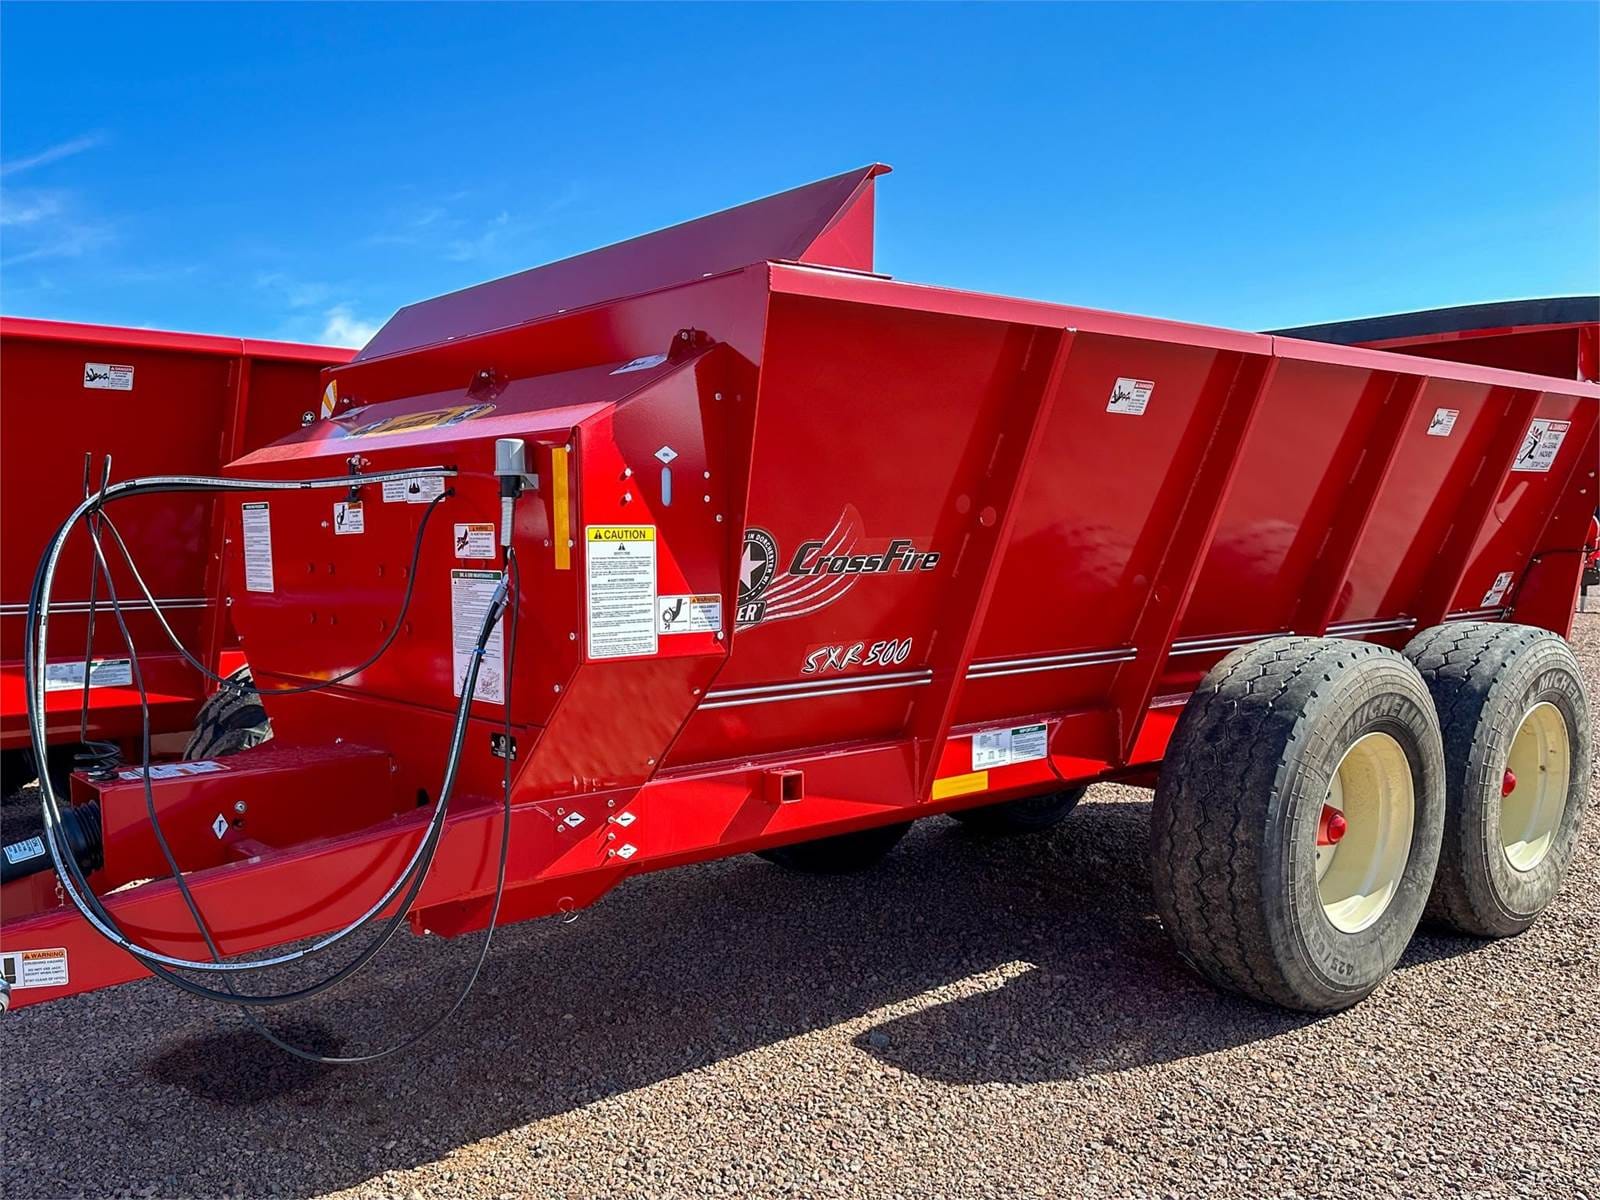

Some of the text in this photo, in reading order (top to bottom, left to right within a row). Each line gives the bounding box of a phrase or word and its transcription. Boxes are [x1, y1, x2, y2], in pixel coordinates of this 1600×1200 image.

[604, 530, 646, 540] CAUTION
[755, 534, 775, 576] DORCHESTER
[788, 539, 940, 577] CrossFire
[801, 637, 913, 674] SXR 500
[31, 951, 64, 959] WARNING
